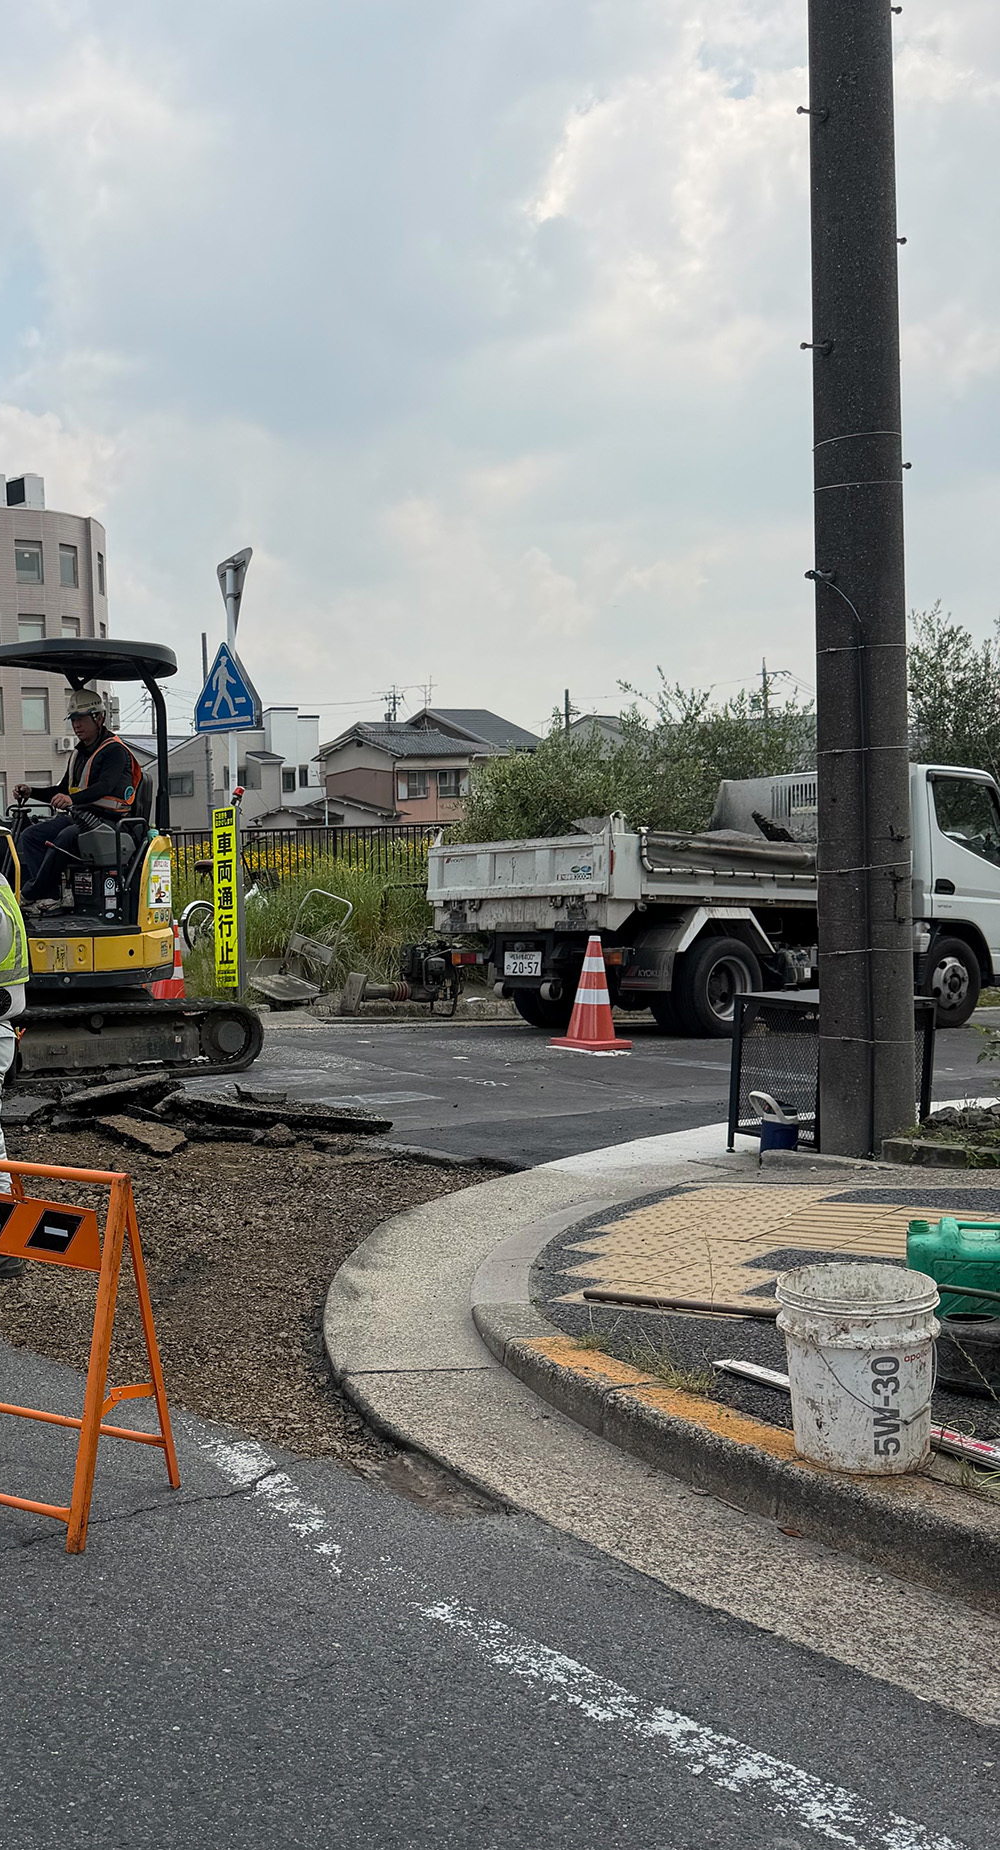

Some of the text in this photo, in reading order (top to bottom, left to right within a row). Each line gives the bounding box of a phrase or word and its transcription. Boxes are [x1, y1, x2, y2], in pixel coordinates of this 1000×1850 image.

[217, 832, 235, 965] 車両通行止
[512, 961, 539, 974] 20-57
[871, 1356, 900, 1456] 5W-30
